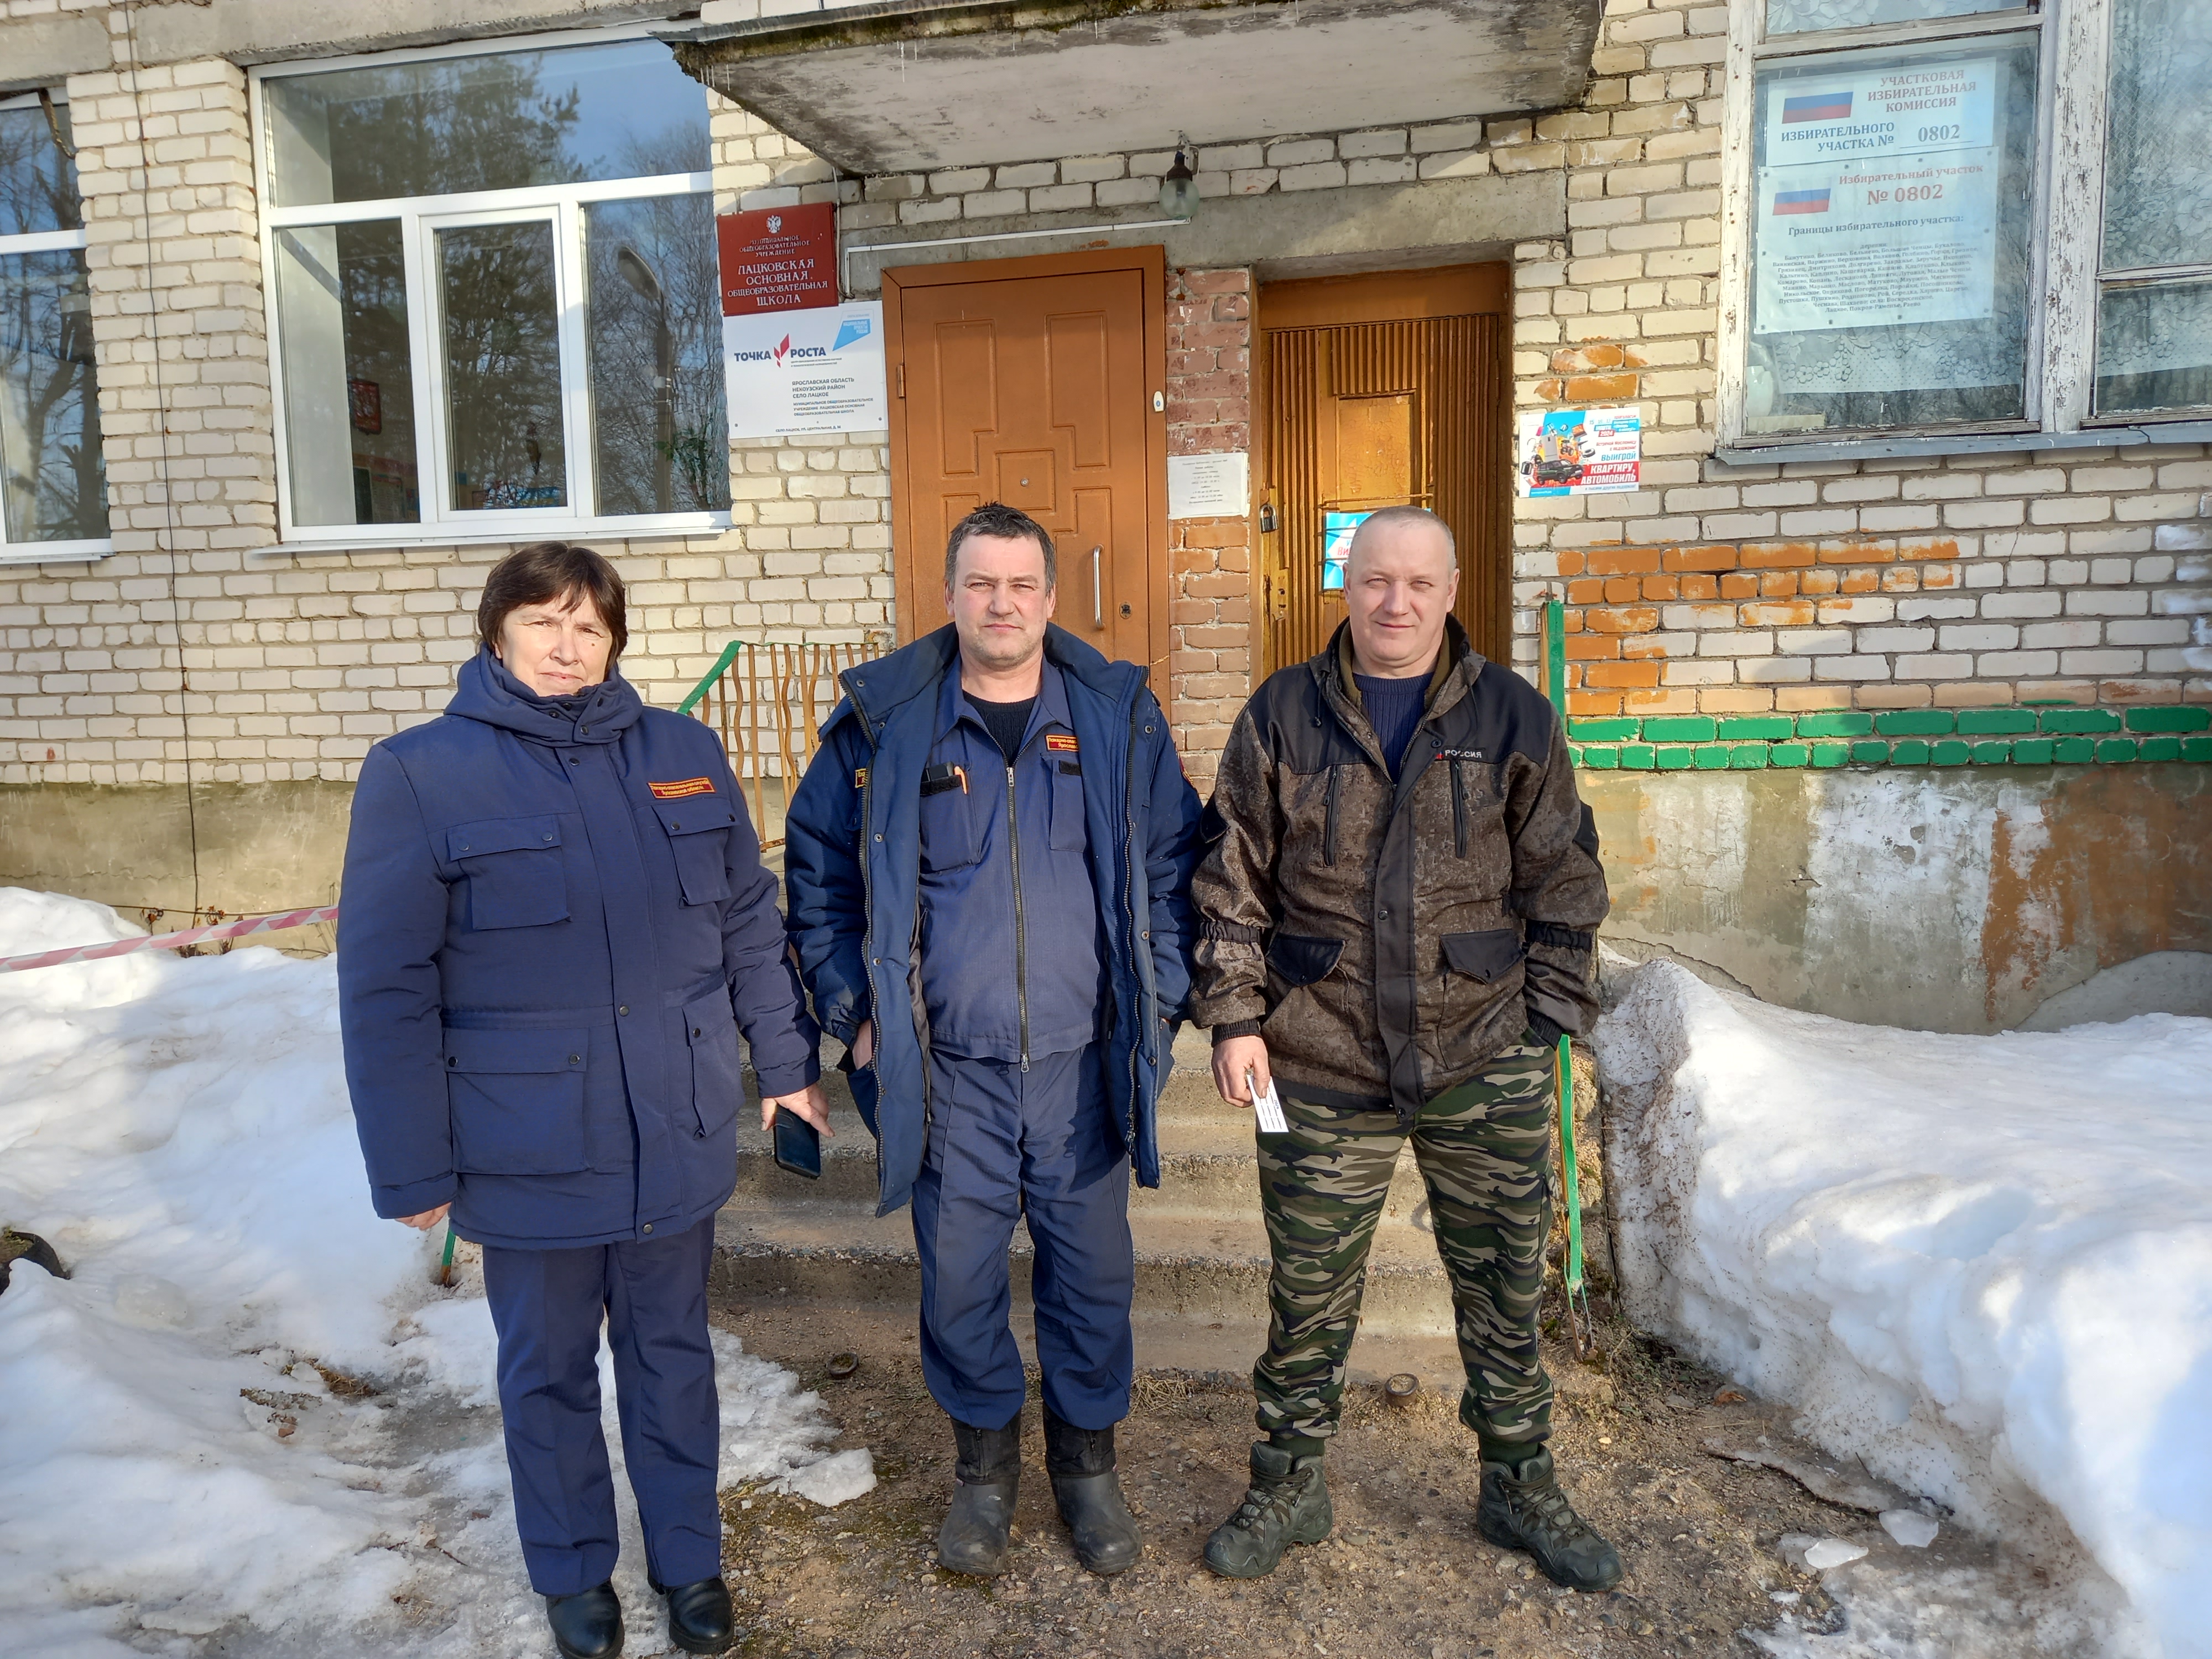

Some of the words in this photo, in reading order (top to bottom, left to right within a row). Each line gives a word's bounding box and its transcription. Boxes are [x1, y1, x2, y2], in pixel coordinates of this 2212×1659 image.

[1880, 69, 1965, 87] УЧАСТКОВАЯ
[1867, 81, 1976, 101] ИЗБИРАТЕЛЬНАЯ
[1885, 97, 1957, 113] КОМИССИЯ
[1781, 122, 1895, 142] ИЗБИРАТЕЛЬНОГО
[1817, 139, 1874, 153] УЧАСТКА
[1877, 134, 1894, 147] №
[1918, 124, 1960, 142] 0802
[1839, 168, 1933, 185] Избирательный
[1936, 164, 1984, 179] участок
[1867, 190, 1888, 205] №
[1894, 184, 1943, 202] 0802
[1788, 226, 1833, 237] Границы
[1835, 218, 1918, 232] избирательного
[1921, 215, 1964, 227] участка:
[755, 249, 795, 257] УЧРЕЖДЕНИЕ
[738, 258, 815, 275] ЛАЦКОВСКАЯ
[746, 271, 808, 286] ОСНОВНАЯ
[727, 280, 828, 298] ОБЩЕОБРАЗОВАТЕЛЬНАЯ
[734, 350, 771, 362] ТОЧКА
[790, 347, 826, 358] РОСТА
[1590, 463, 1635, 474] КВАРТИРУ,
[1580, 473, 1636, 484] АВТОМОБИЛЬ
